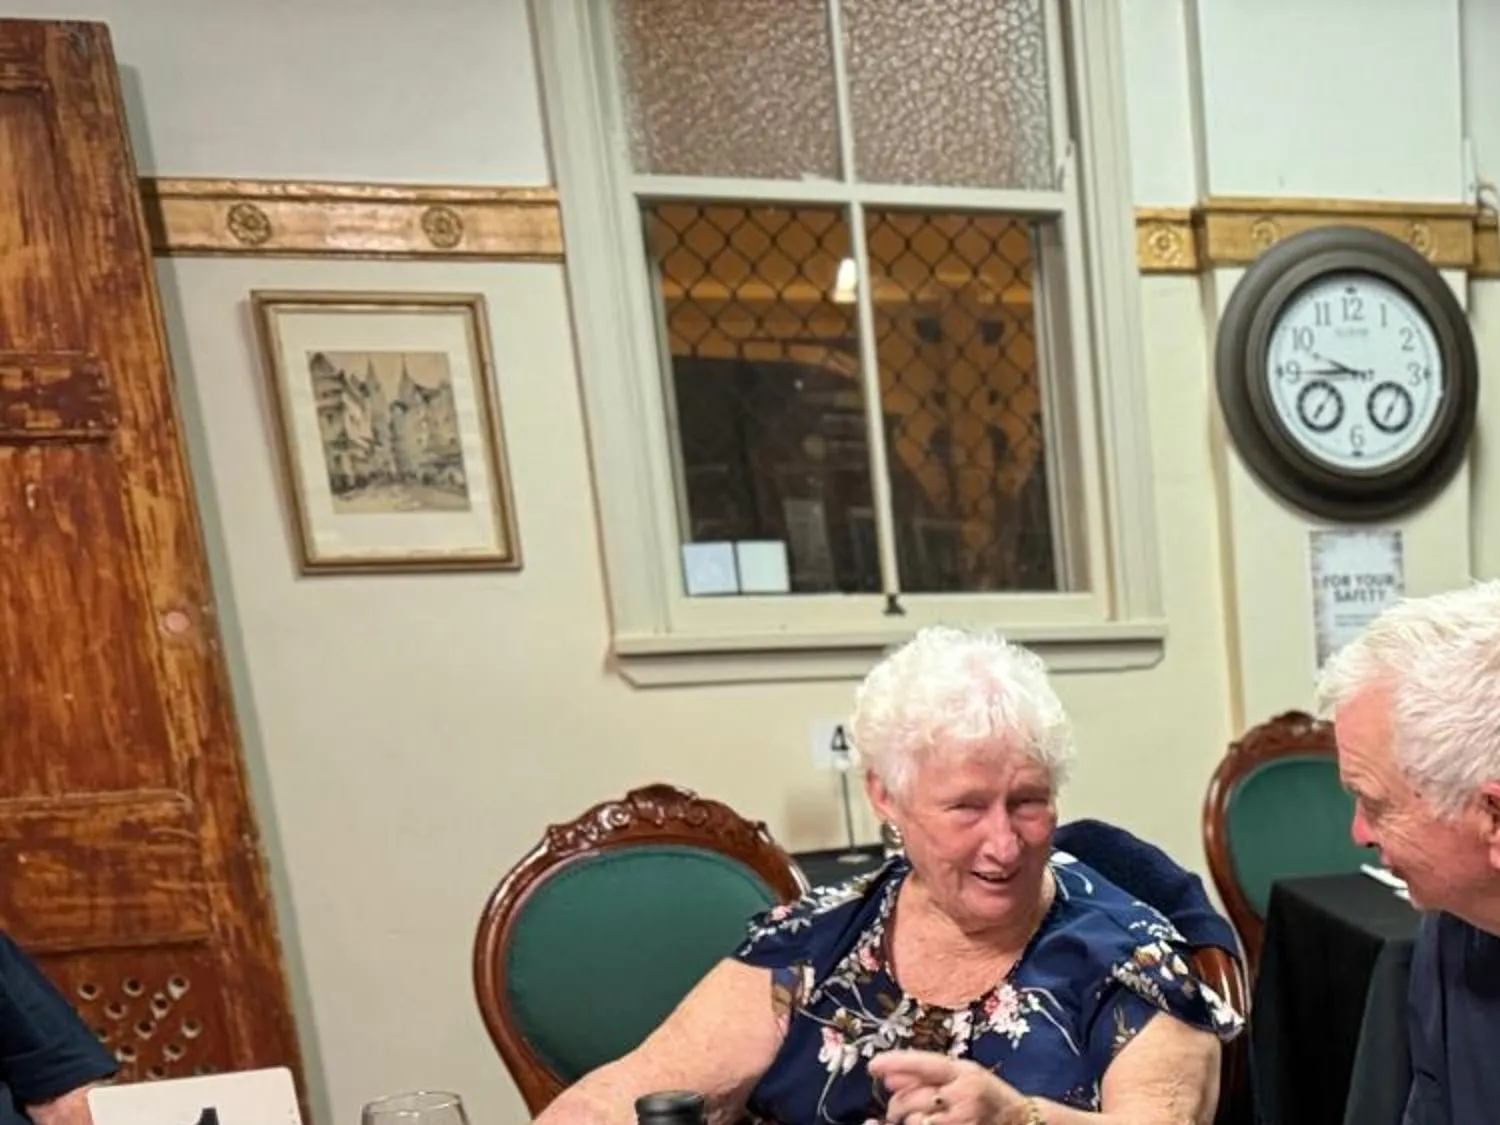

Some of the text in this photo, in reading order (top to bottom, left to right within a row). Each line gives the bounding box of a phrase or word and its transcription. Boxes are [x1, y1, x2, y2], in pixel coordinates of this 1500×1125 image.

[1314, 302, 1331, 326] 11
[1342, 297, 1364, 321] 12
[1380, 303, 1388, 328] 1
[1292, 326, 1315, 351] 10
[1399, 327, 1415, 351] 2
[1285, 360, 1301, 385] 9
[1407, 362, 1422, 386] 3
[1350, 424, 1364, 448] 6
[830, 724, 849, 757] 4
